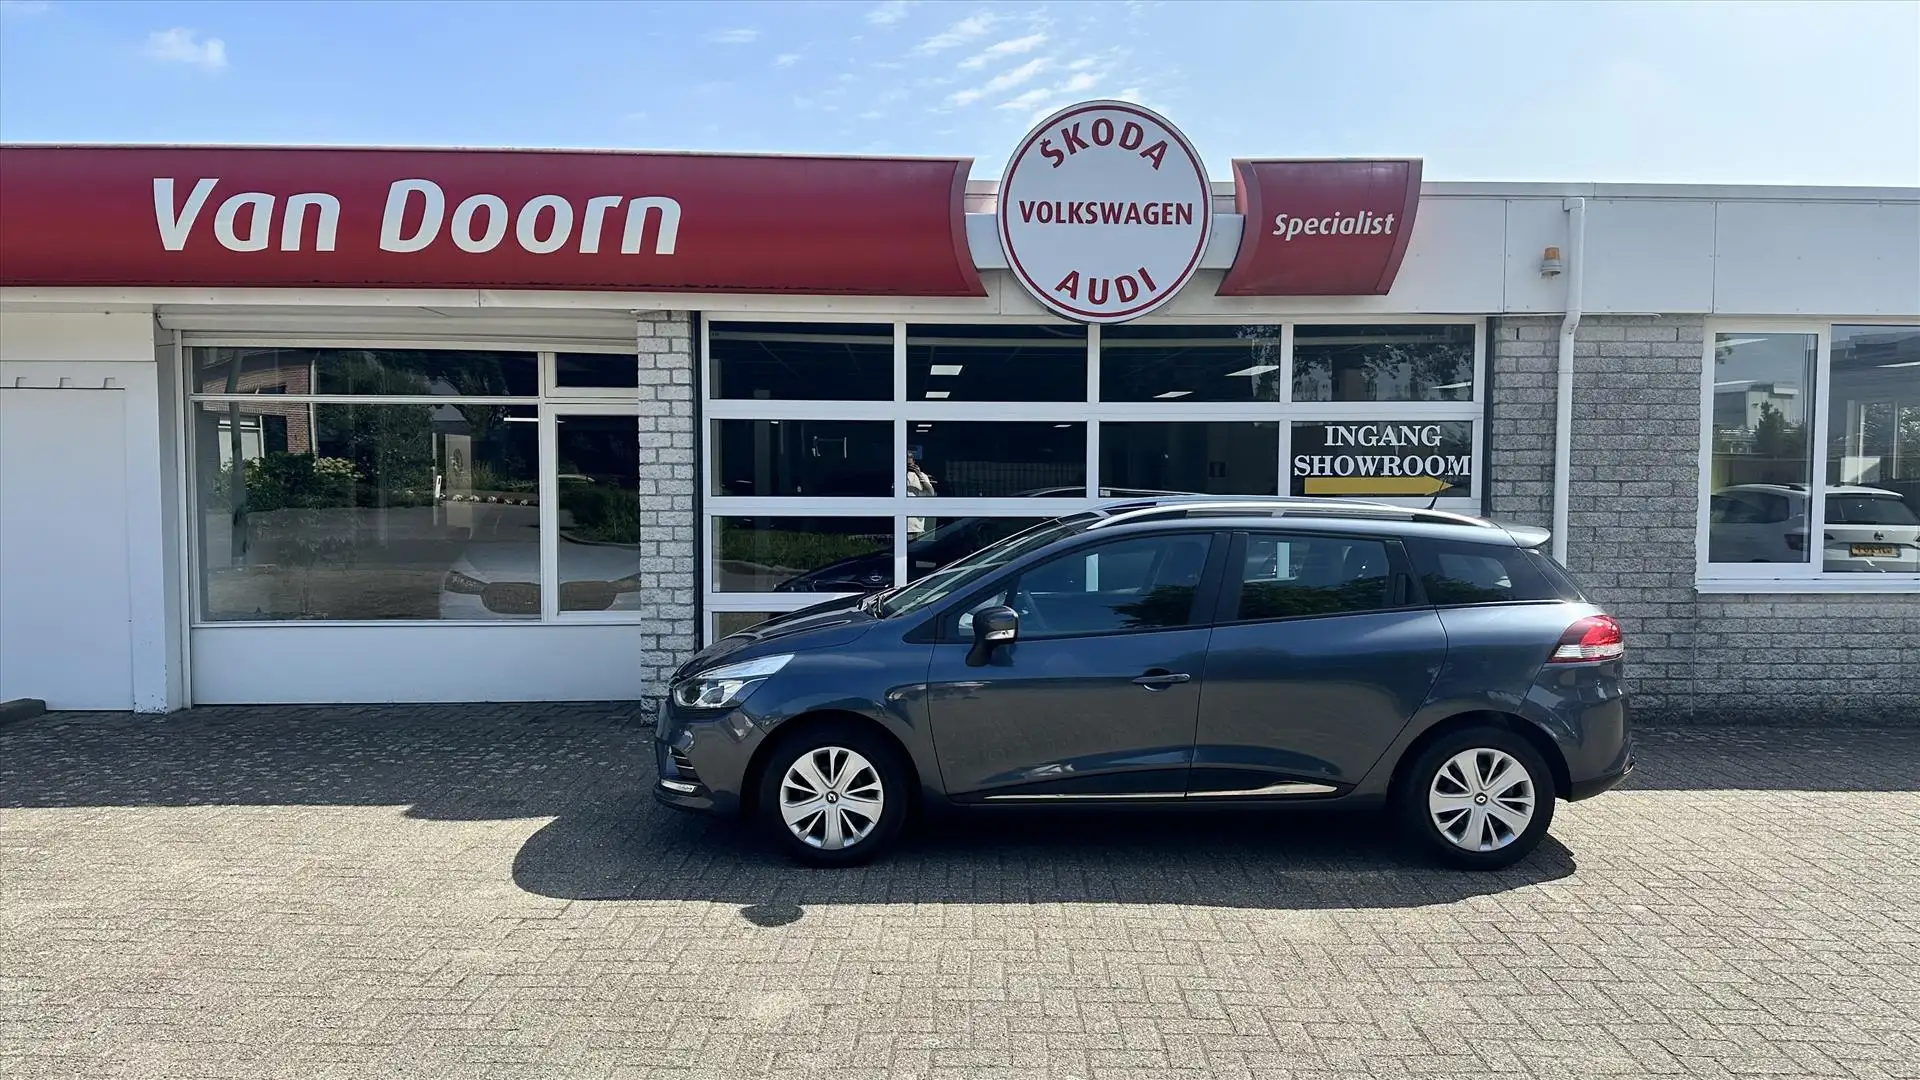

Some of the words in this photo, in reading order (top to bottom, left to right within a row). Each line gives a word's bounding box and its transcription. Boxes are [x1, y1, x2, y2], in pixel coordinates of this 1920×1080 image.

[1040, 118, 1169, 171] ŠKODA
[153, 178, 341, 252] Van
[379, 178, 682, 255] Doorn
[1019, 201, 1193, 225] VOLKSWAGEN
[1273, 211, 1395, 241] Specialist
[1055, 267, 1157, 305] AUDI
[1324, 425, 1442, 447] INGANG
[1294, 454, 1472, 477] SHOWROOM
